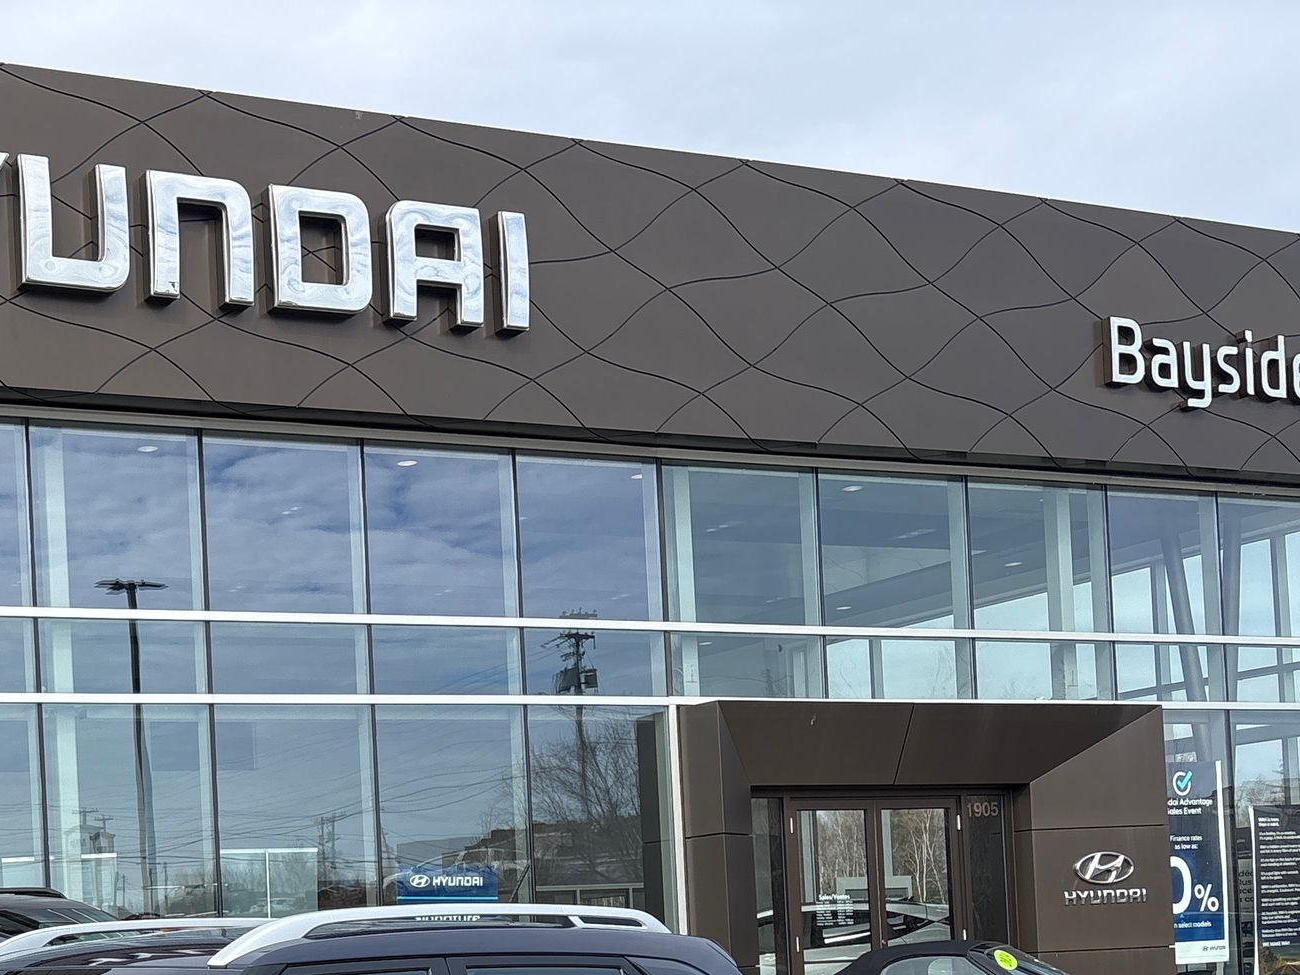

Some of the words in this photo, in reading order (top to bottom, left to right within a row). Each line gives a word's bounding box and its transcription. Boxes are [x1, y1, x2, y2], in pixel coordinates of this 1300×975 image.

[967, 801, 999, 817] 1905
[1183, 807, 1202, 815] Event
[433, 876, 483, 887] HYUNDAI
[1064, 888, 1147, 906] HYUNDAI
